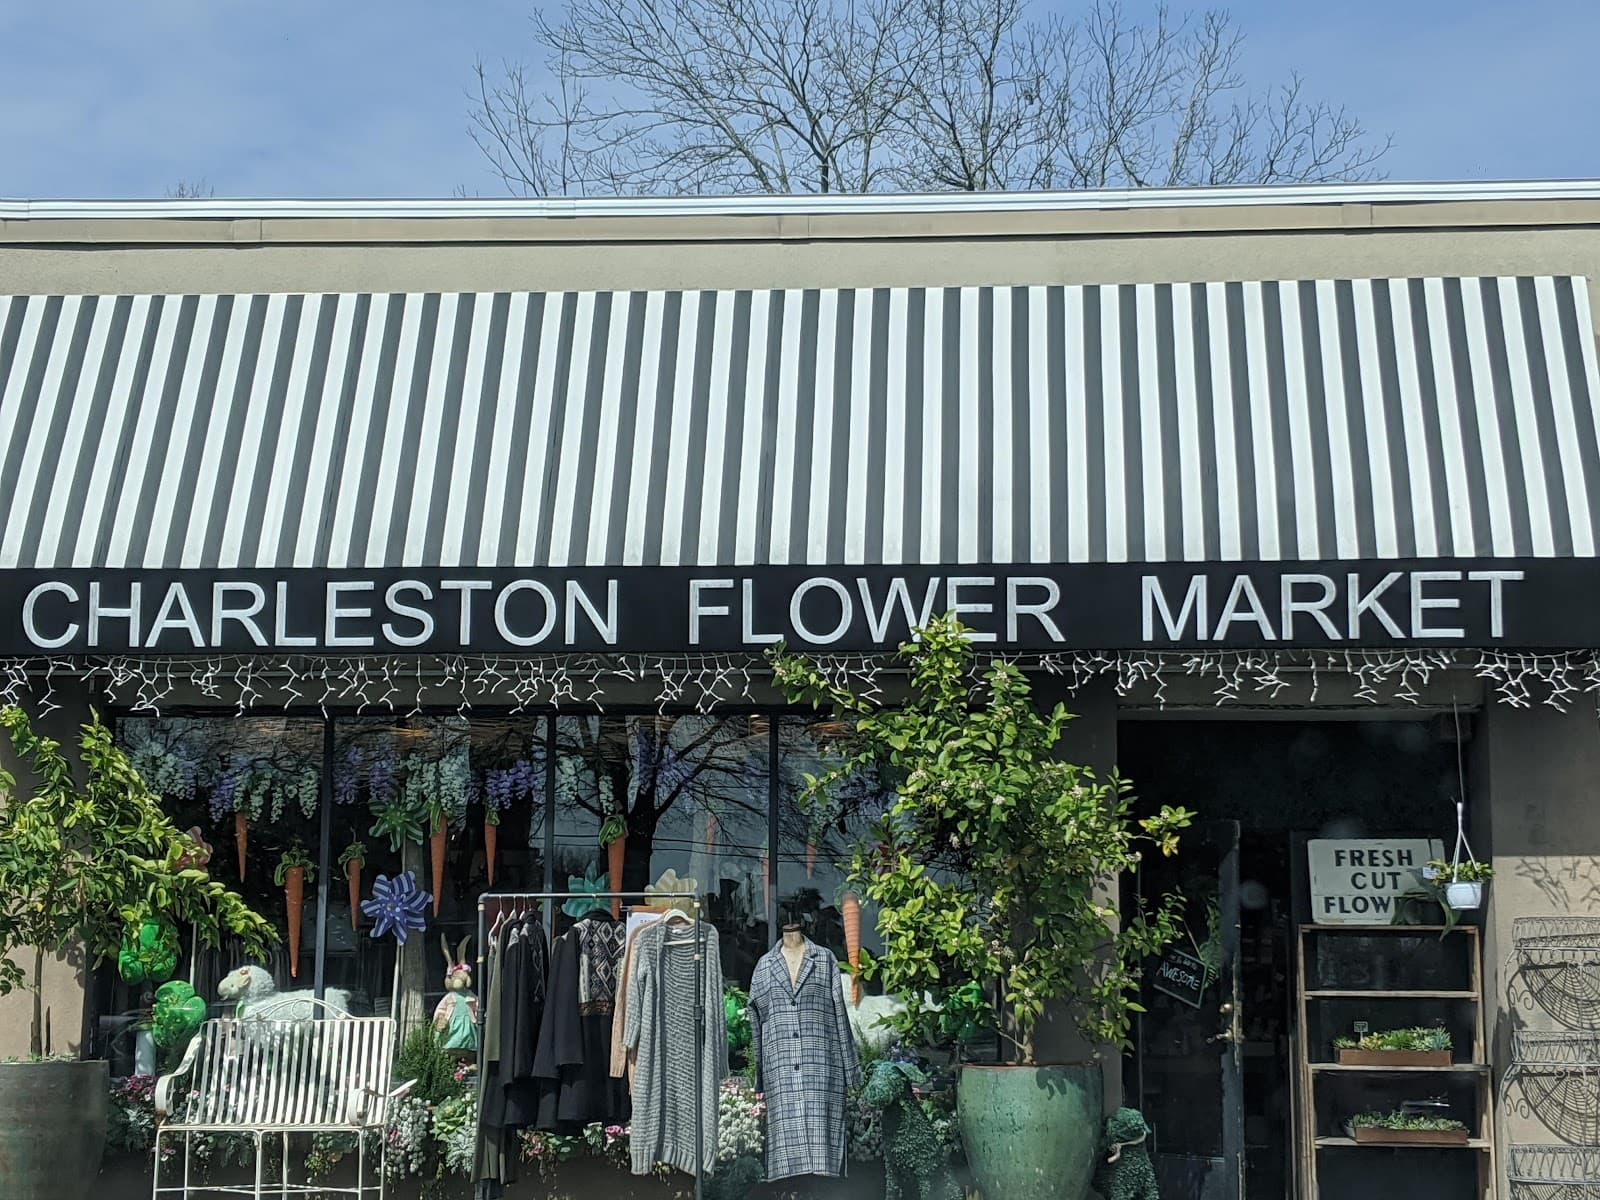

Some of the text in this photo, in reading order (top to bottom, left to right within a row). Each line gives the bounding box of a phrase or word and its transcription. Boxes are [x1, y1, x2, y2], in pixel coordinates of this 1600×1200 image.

[21, 569, 1525, 649] CHARLESTON FLOWER MARKET
[1334, 849, 1413, 867] FRESH
[1351, 871, 1402, 890] CUT
